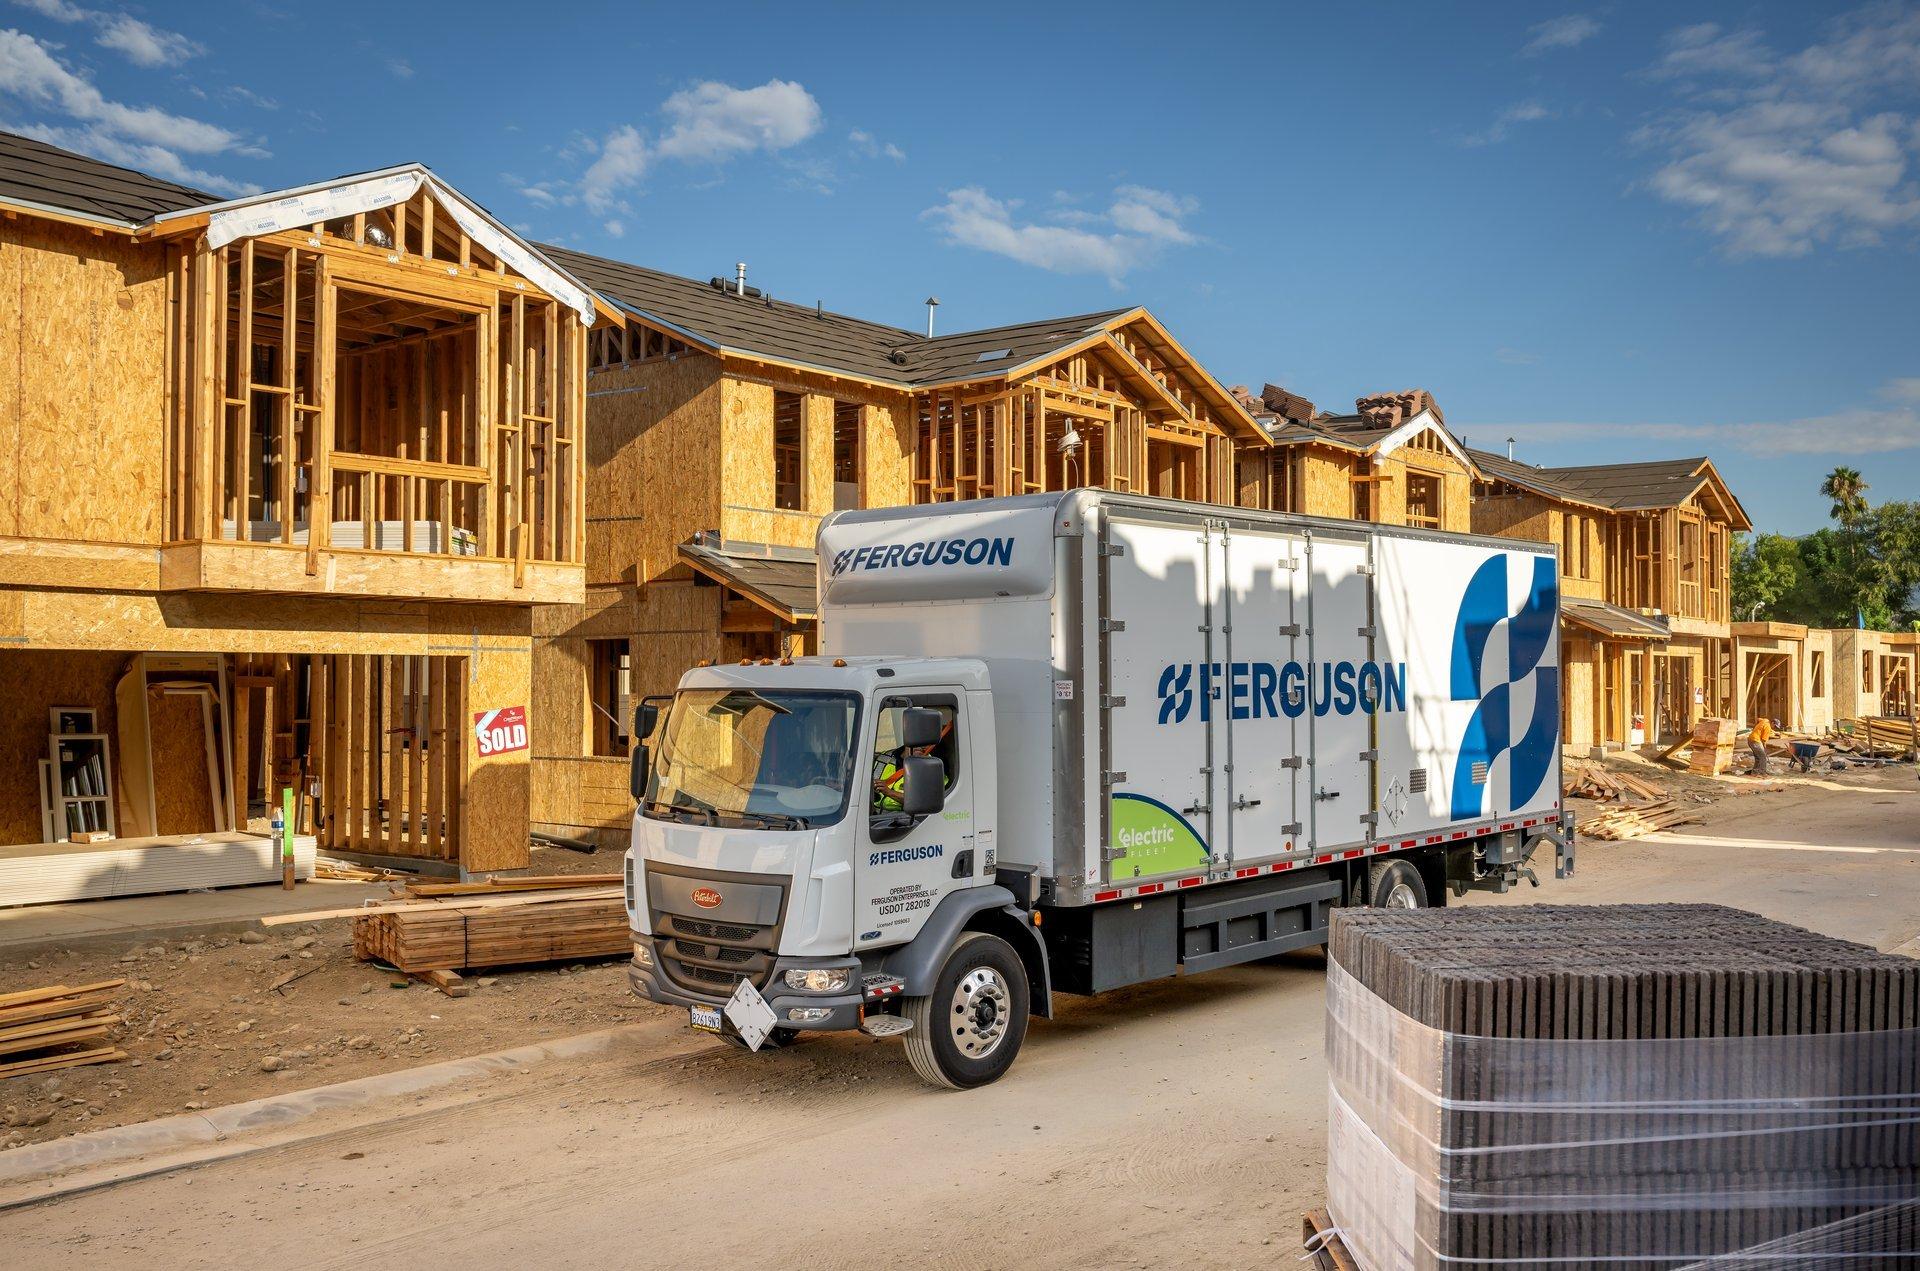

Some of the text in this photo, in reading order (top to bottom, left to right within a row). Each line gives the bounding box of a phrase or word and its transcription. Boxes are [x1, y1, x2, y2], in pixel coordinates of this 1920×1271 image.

[850, 537, 1015, 572] FERGUSON
[1199, 661, 1406, 722] FERGUSON
[479, 724, 527, 754] SOLD
[1119, 823, 1175, 848] electric
[880, 844, 943, 865] FERGUSON
[1131, 846, 1167, 858] FLEET
[871, 895, 898, 906] FERGUSON
[929, 888, 938, 896] LLC
[889, 885, 915, 896] OPERATED
[879, 898, 931, 916] USDOT 282018
